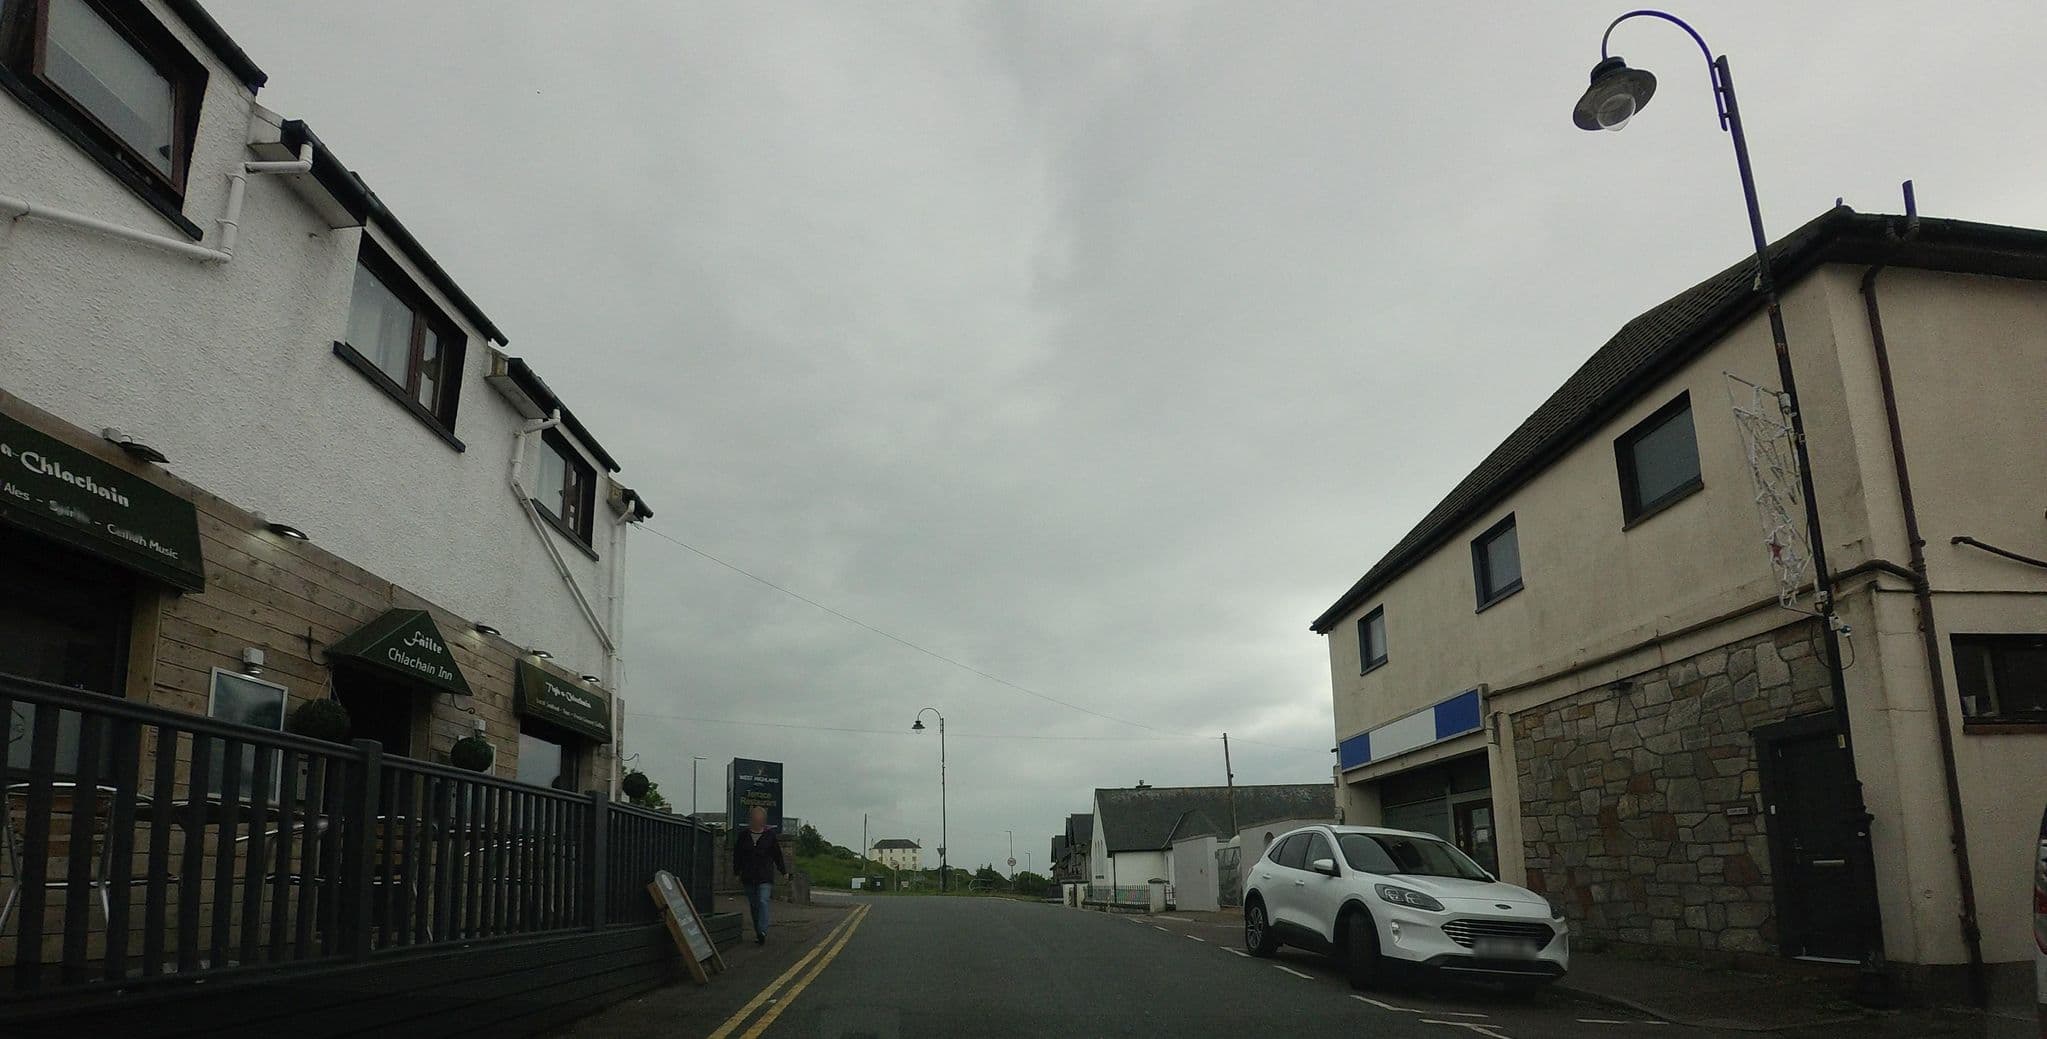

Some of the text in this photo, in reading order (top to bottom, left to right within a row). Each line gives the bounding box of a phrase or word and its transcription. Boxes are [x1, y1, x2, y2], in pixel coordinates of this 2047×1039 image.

[4, 482, 31, 501] Ales
[149, 539, 179, 560] Music
[388, 647, 453, 681] Chlachain Inn
